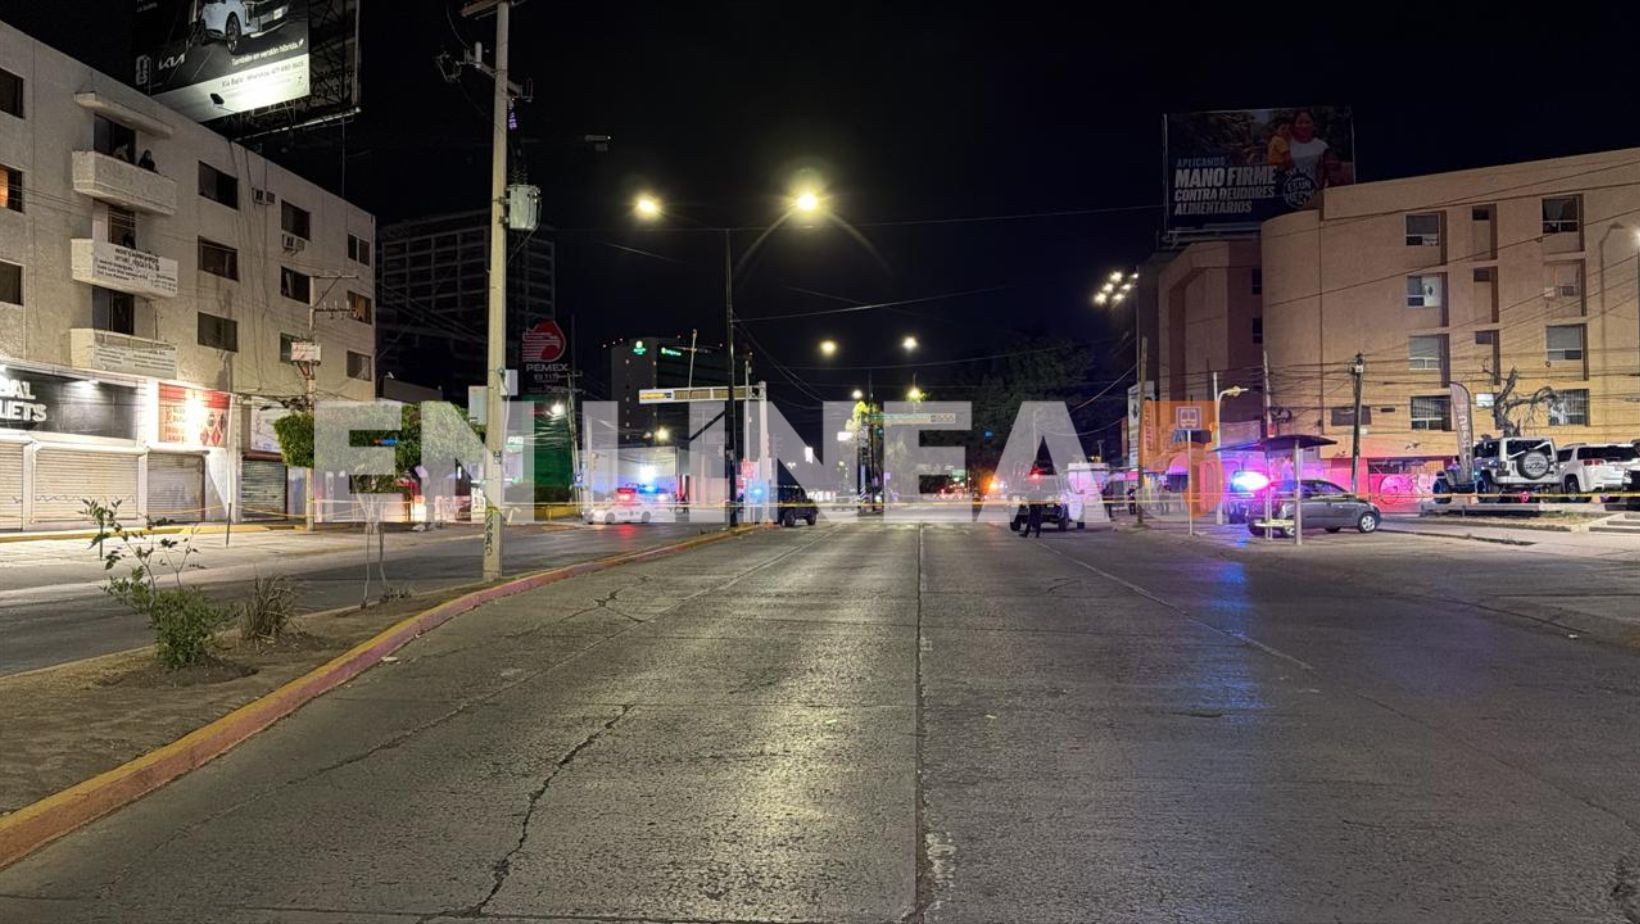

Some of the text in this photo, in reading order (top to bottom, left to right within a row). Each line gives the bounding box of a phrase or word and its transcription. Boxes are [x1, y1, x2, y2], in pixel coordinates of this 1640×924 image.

[1175, 165, 1277, 188] MANO FIRME
[1175, 188, 1218, 202] CONTRA
[1219, 185, 1276, 201] DEUDORES
[1175, 200, 1253, 215] ALIMENTARIOS
[526, 362, 569, 373] PEMEX
